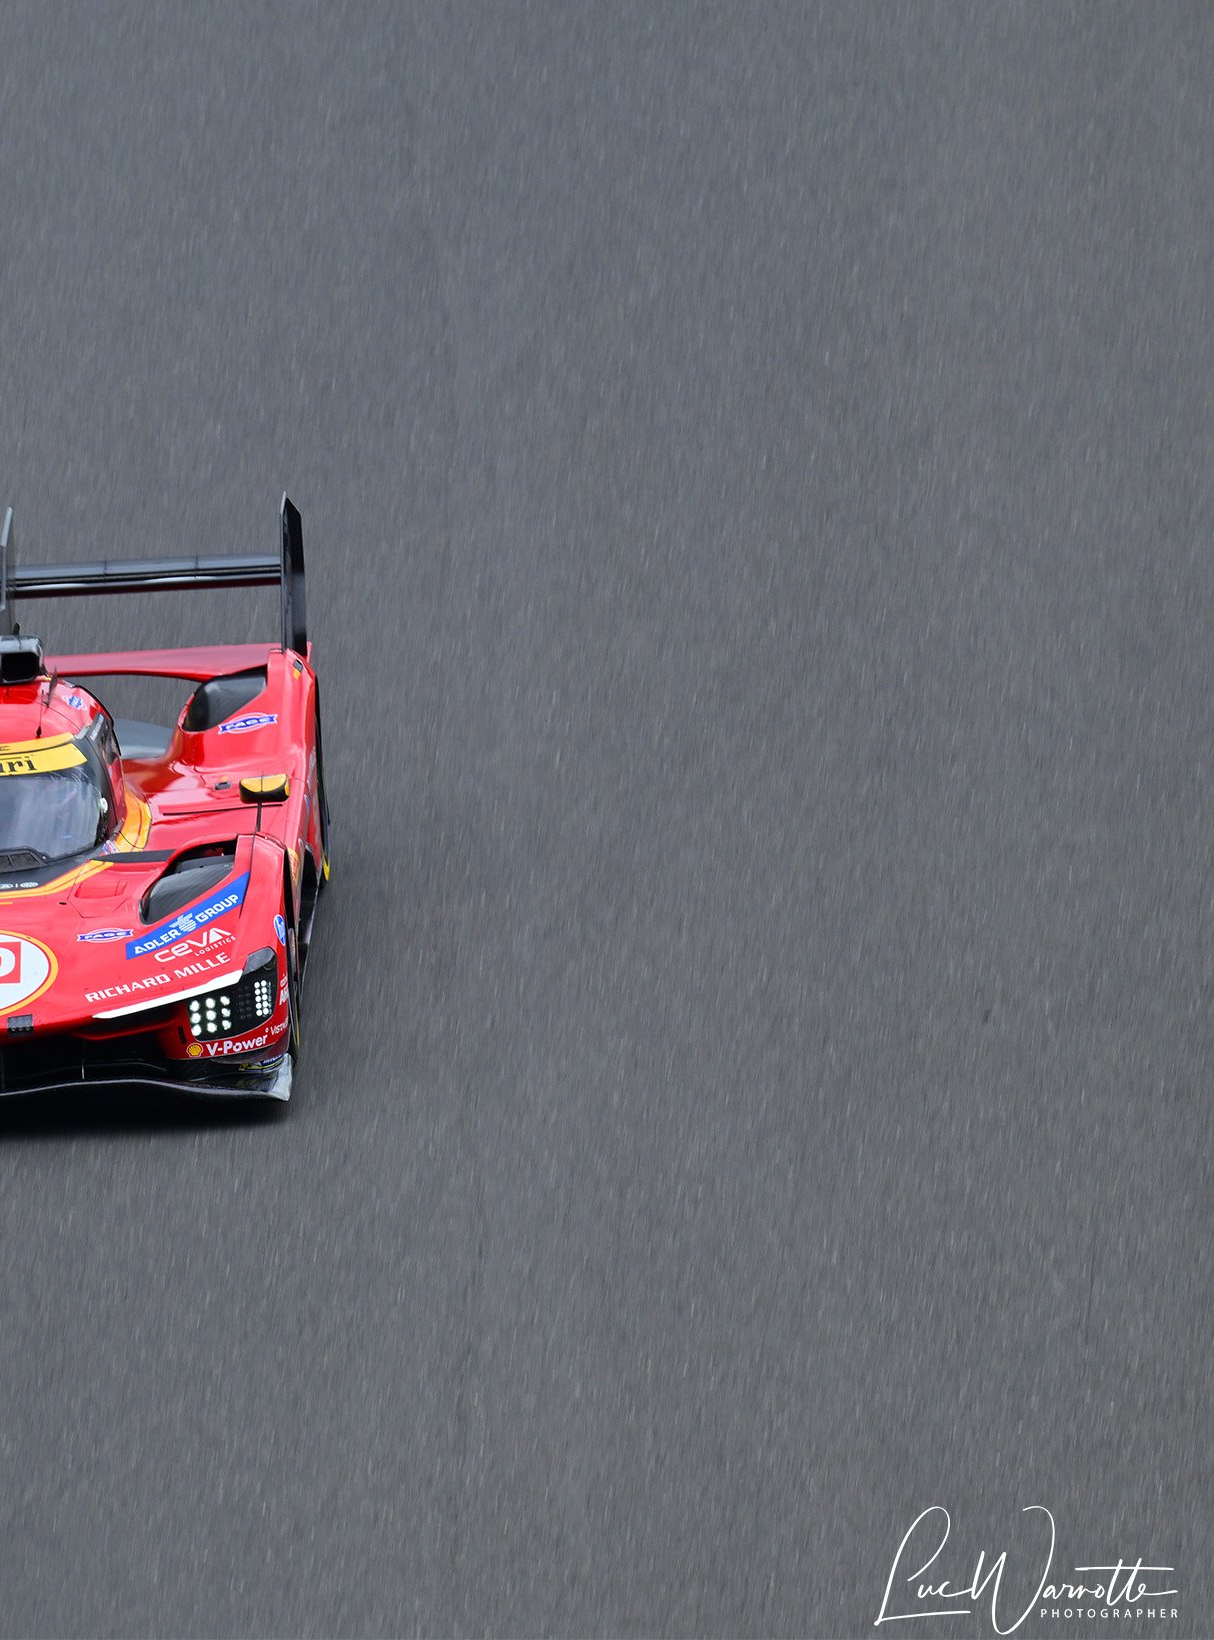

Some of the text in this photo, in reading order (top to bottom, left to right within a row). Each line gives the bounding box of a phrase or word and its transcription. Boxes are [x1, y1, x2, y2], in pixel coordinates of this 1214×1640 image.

[134, 894, 239, 955] ADLER GROUP
[194, 936, 236, 957] LOGISTICS
[85, 952, 231, 1003] RICHARD MILLE
[205, 1034, 268, 1056] V-Power
